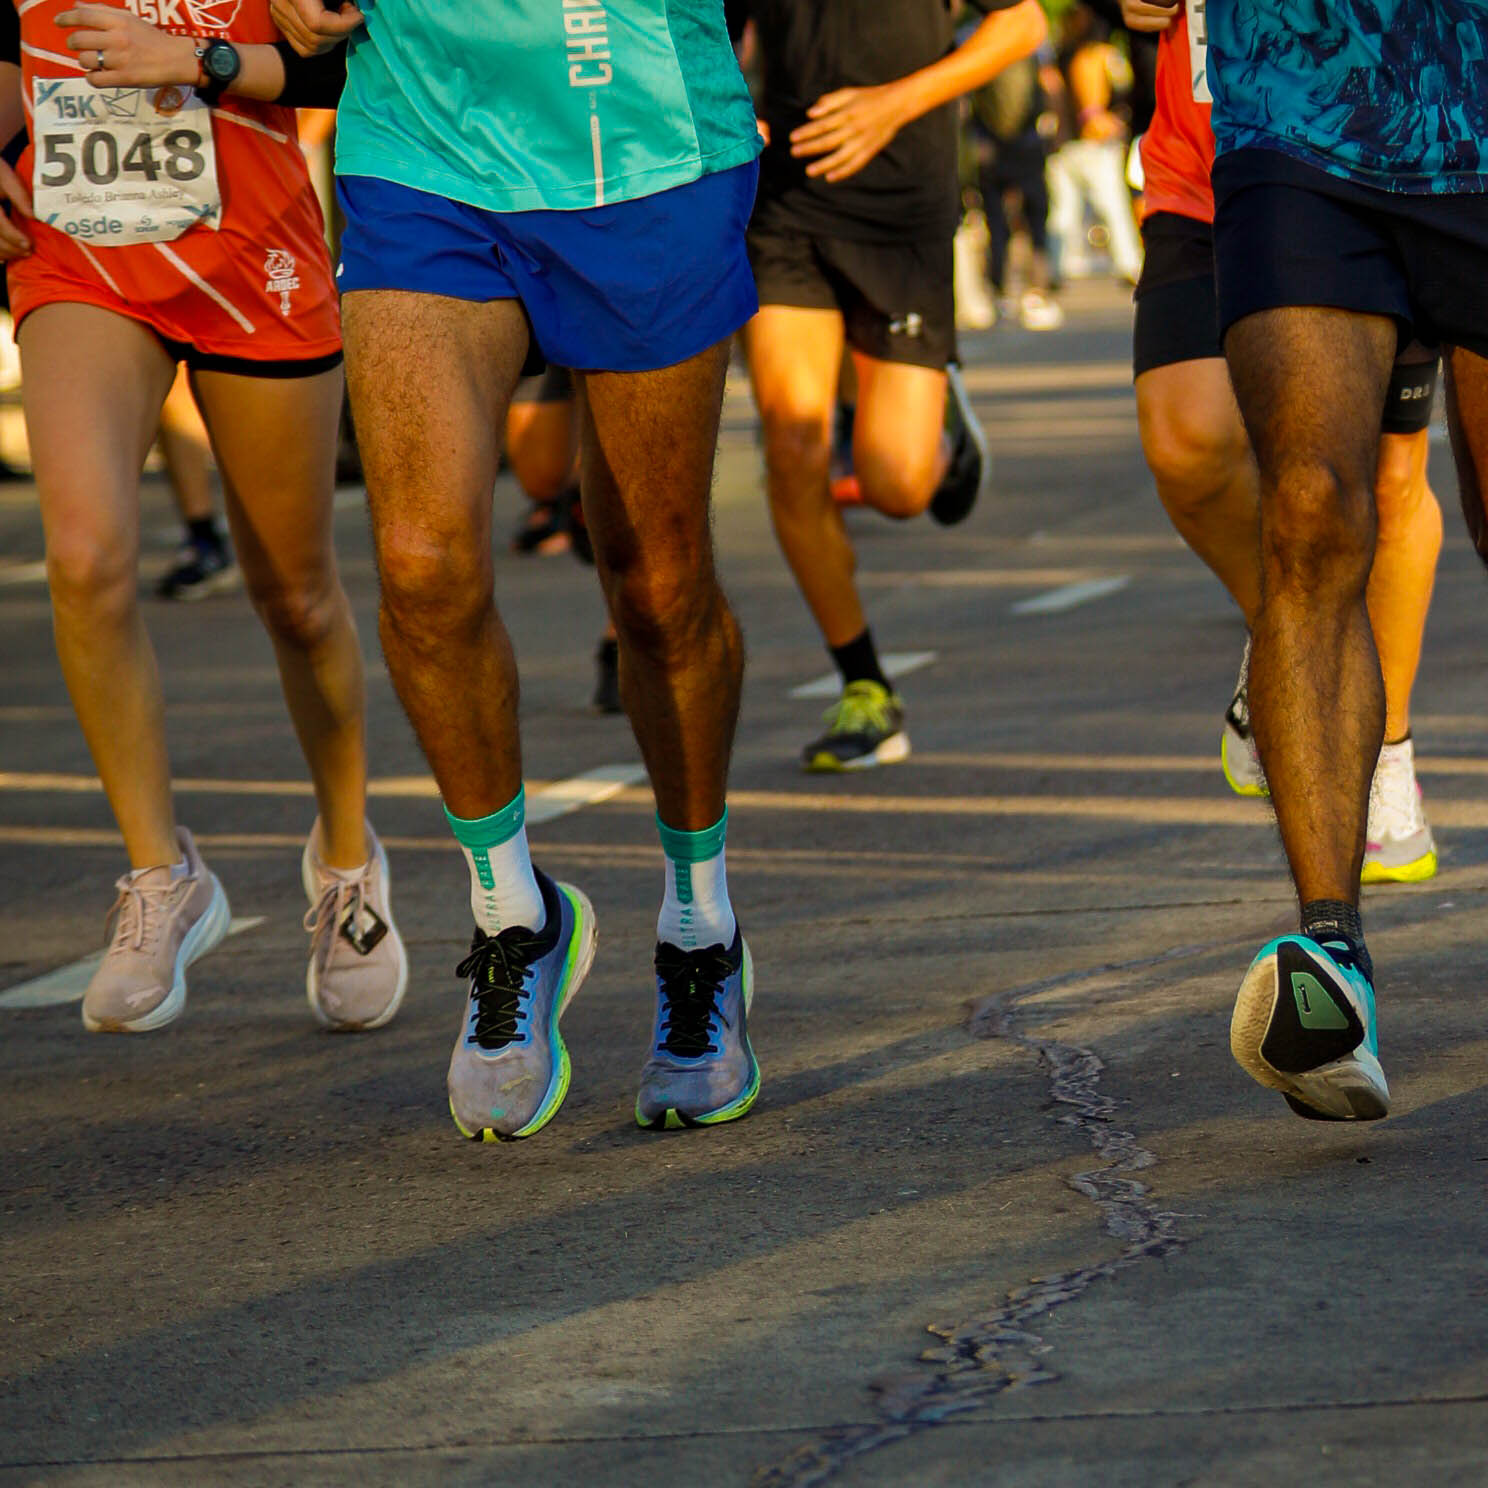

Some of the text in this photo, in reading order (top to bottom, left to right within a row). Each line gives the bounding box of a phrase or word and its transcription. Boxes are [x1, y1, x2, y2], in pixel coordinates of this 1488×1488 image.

[53, 95, 97, 119] 15K
[41, 129, 205, 187] 5048
[64, 215, 123, 238] osde
